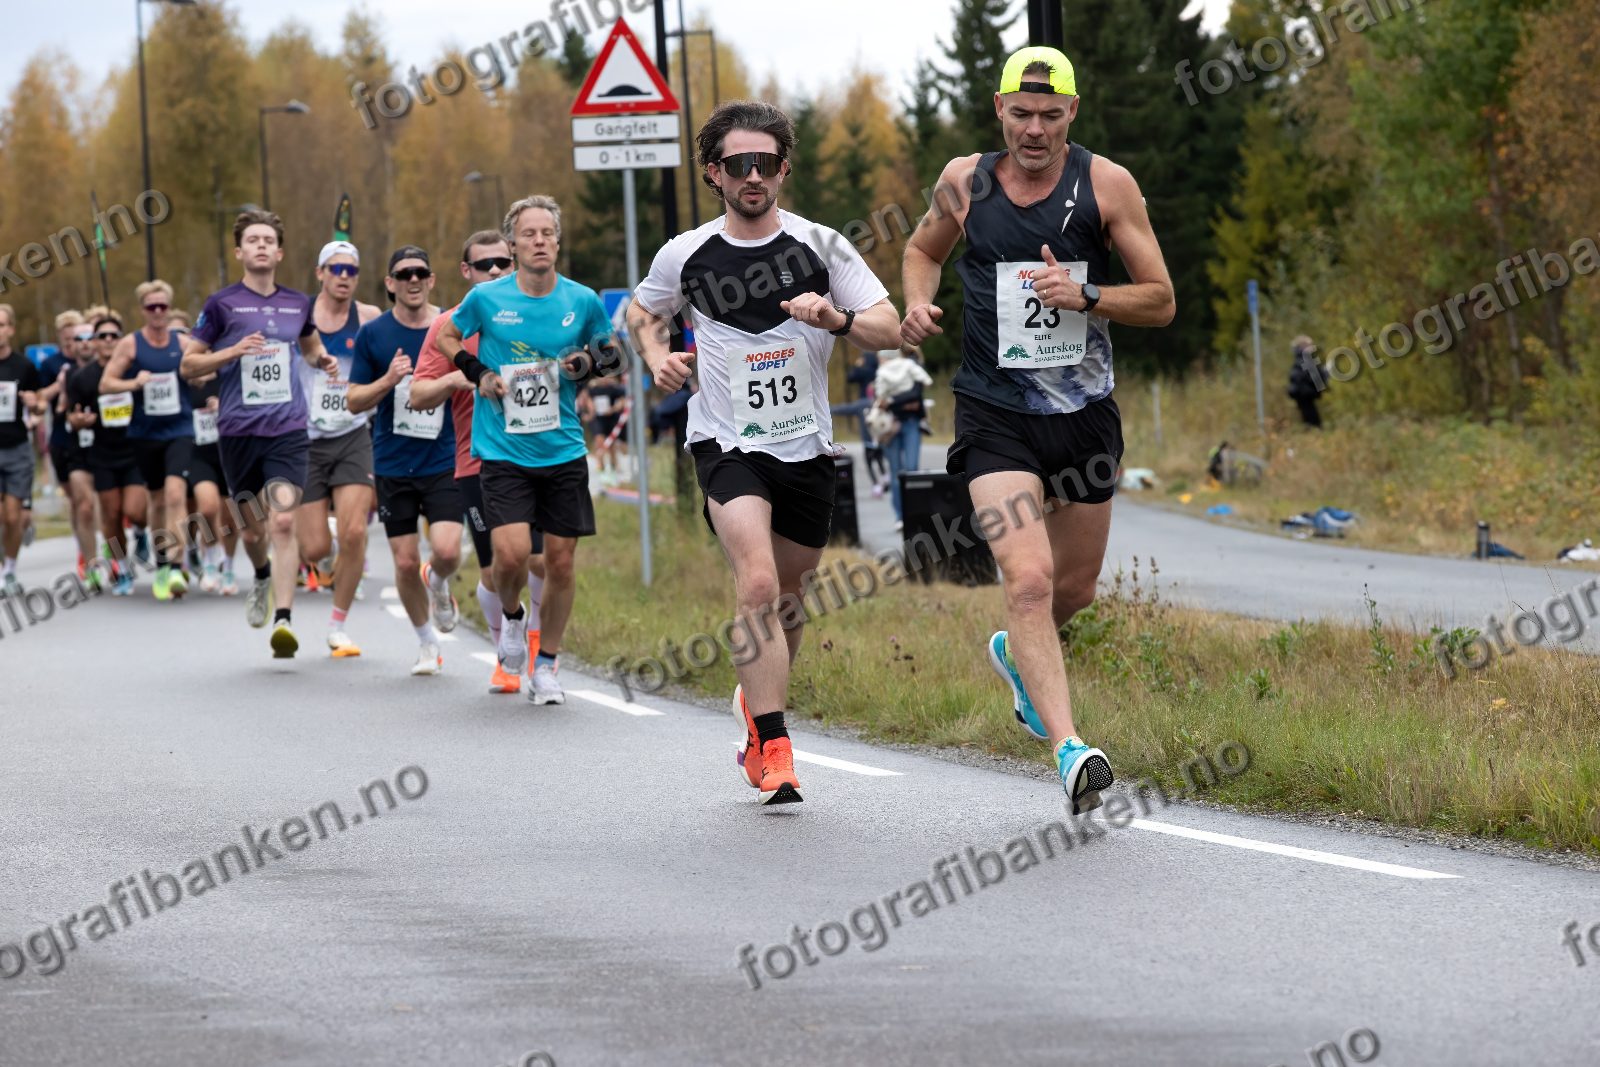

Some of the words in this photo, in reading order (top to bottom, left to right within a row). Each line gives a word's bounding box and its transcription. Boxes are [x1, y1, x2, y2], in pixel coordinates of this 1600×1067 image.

[594, 122, 659, 137] Gangfelt
[599, 151, 610, 165] 0
[624, 150, 631, 163] 1
[634, 149, 657, 162] km
[1024, 297, 1061, 328] 23
[1034, 333, 1052, 341] ELITE
[743, 347, 796, 363] NORGES
[1035, 342, 1083, 355] Aurskog
[251, 363, 281, 382] 489
[750, 357, 789, 372] LØPET
[513, 385, 549, 408] 422
[748, 375, 798, 410] 513
[528, 414, 558, 425] Aurskog
[770, 413, 814, 431] Aurskog
